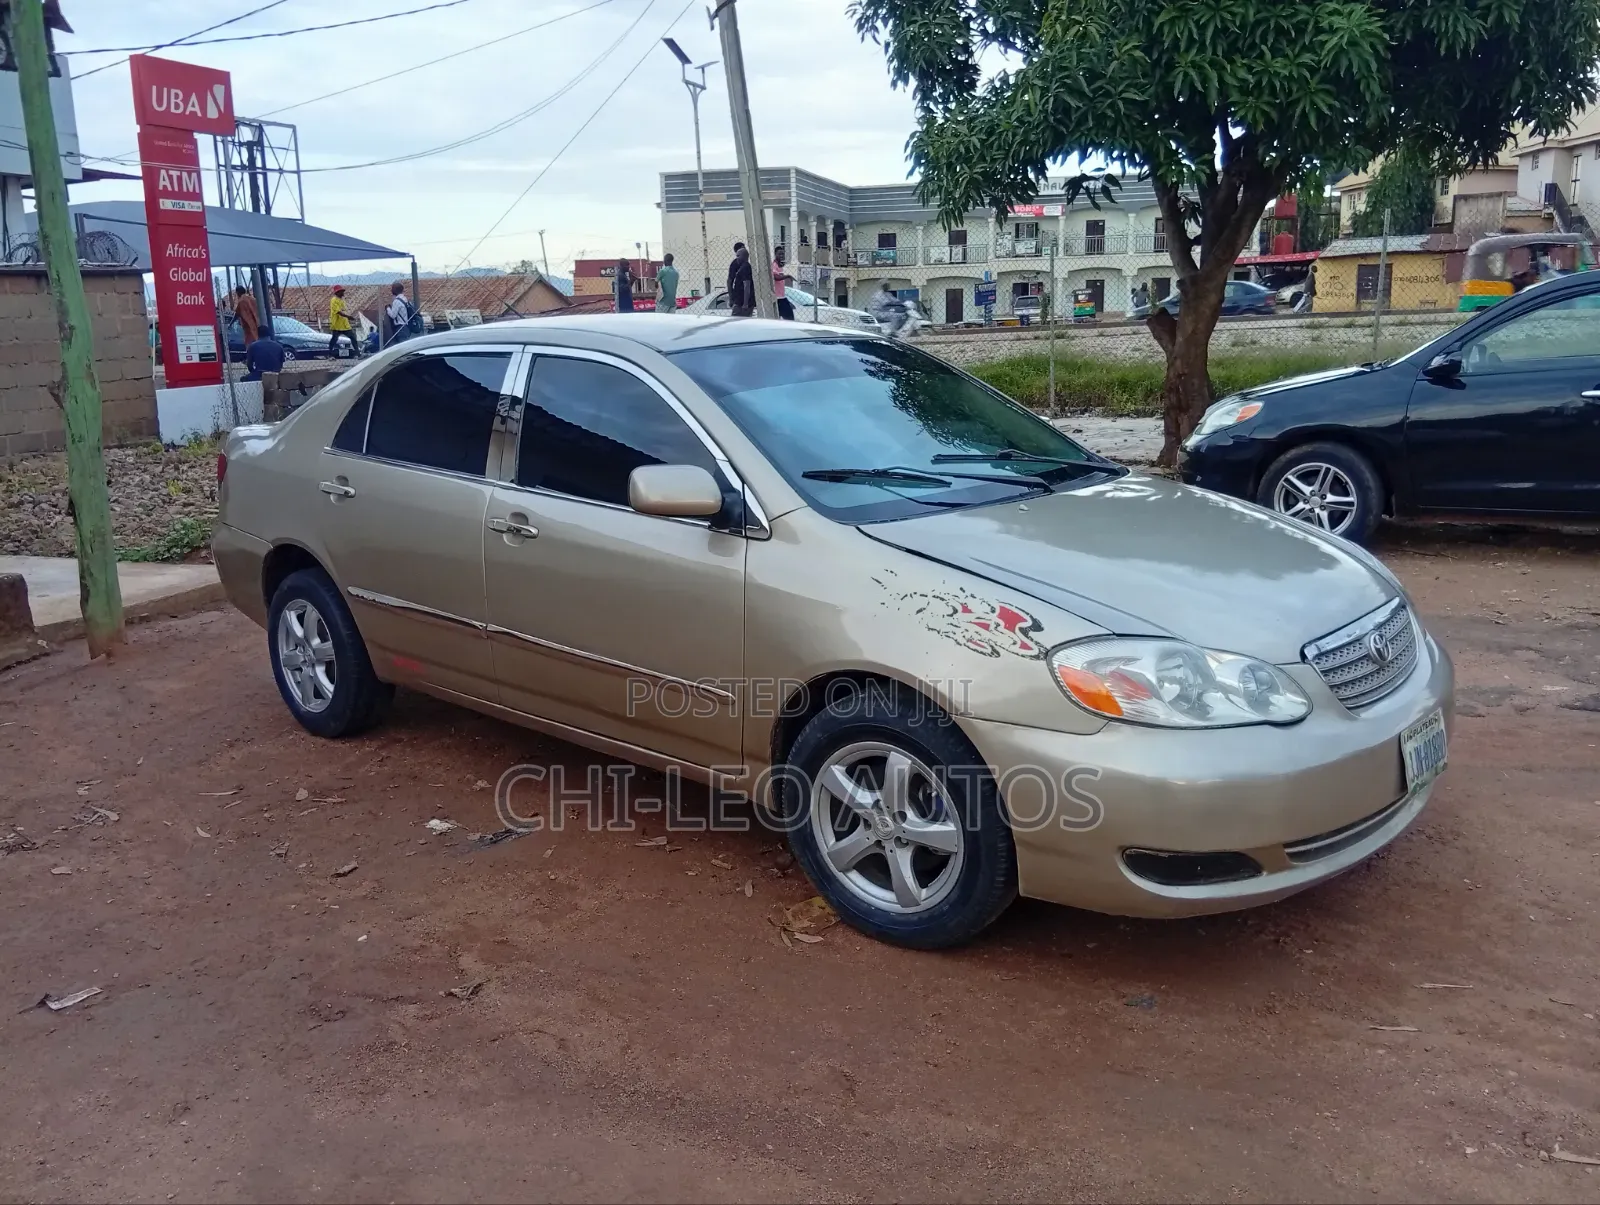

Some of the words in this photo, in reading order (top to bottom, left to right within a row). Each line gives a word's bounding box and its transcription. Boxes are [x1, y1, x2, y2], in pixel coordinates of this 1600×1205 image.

[152, 85, 202, 117] UBA
[159, 169, 200, 193] ATM
[171, 201, 185, 209] VISA
[166, 243, 206, 259] Africa's
[169, 267, 206, 282] Global
[176, 291, 205, 306] Bank
